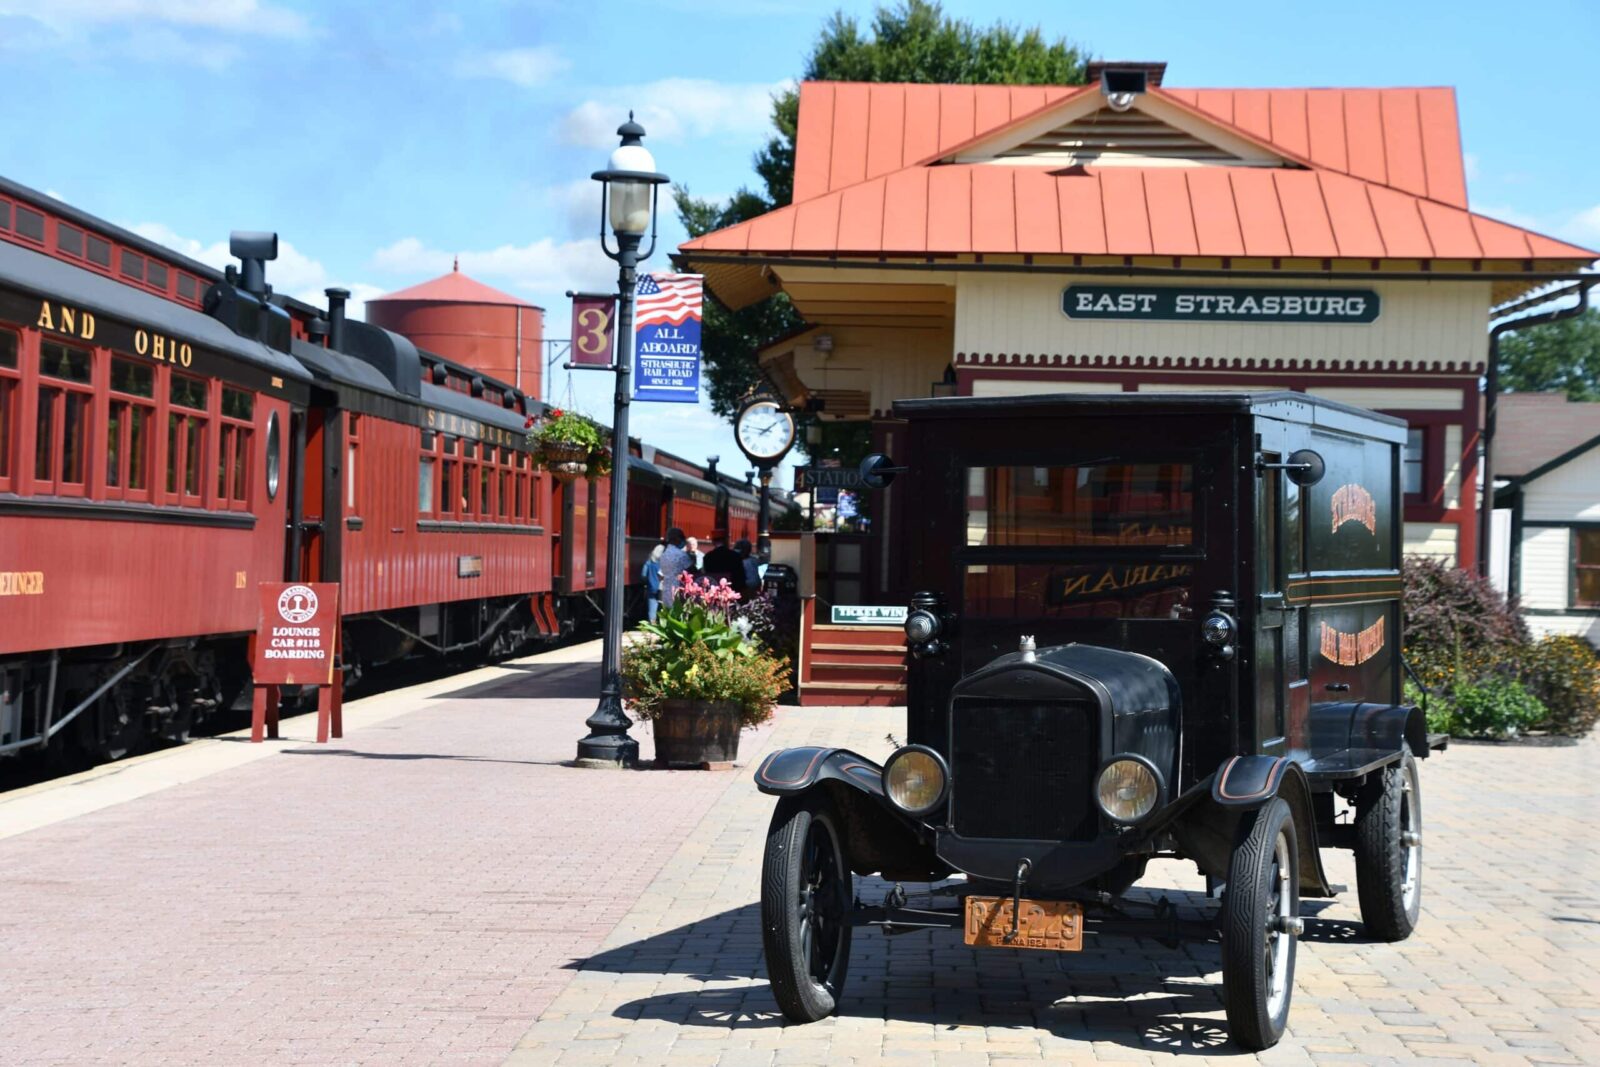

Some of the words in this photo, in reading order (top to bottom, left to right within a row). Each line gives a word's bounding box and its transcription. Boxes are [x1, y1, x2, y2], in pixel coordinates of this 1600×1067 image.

[1076, 293, 1157, 312] EAST
[1175, 295, 1366, 315] STRASBURG
[37, 301, 96, 340] AND
[134, 329, 193, 368] OHIO
[577, 308, 609, 355] 3
[654, 328, 685, 340] ALL
[640, 342, 698, 354] ABOARD!
[641, 360, 695, 369] STRASBURG
[643, 368, 666, 377] RAIL
[668, 369, 693, 378] ROAD
[427, 409, 512, 446] STRASBURG
[806, 470, 862, 486] STATIO
[838, 607, 878, 617] TICKET
[272, 627, 320, 637] LOUNGE
[271, 639, 295, 648] CAR
[296, 639, 320, 648] #118
[264, 649, 325, 659] BOARDING
